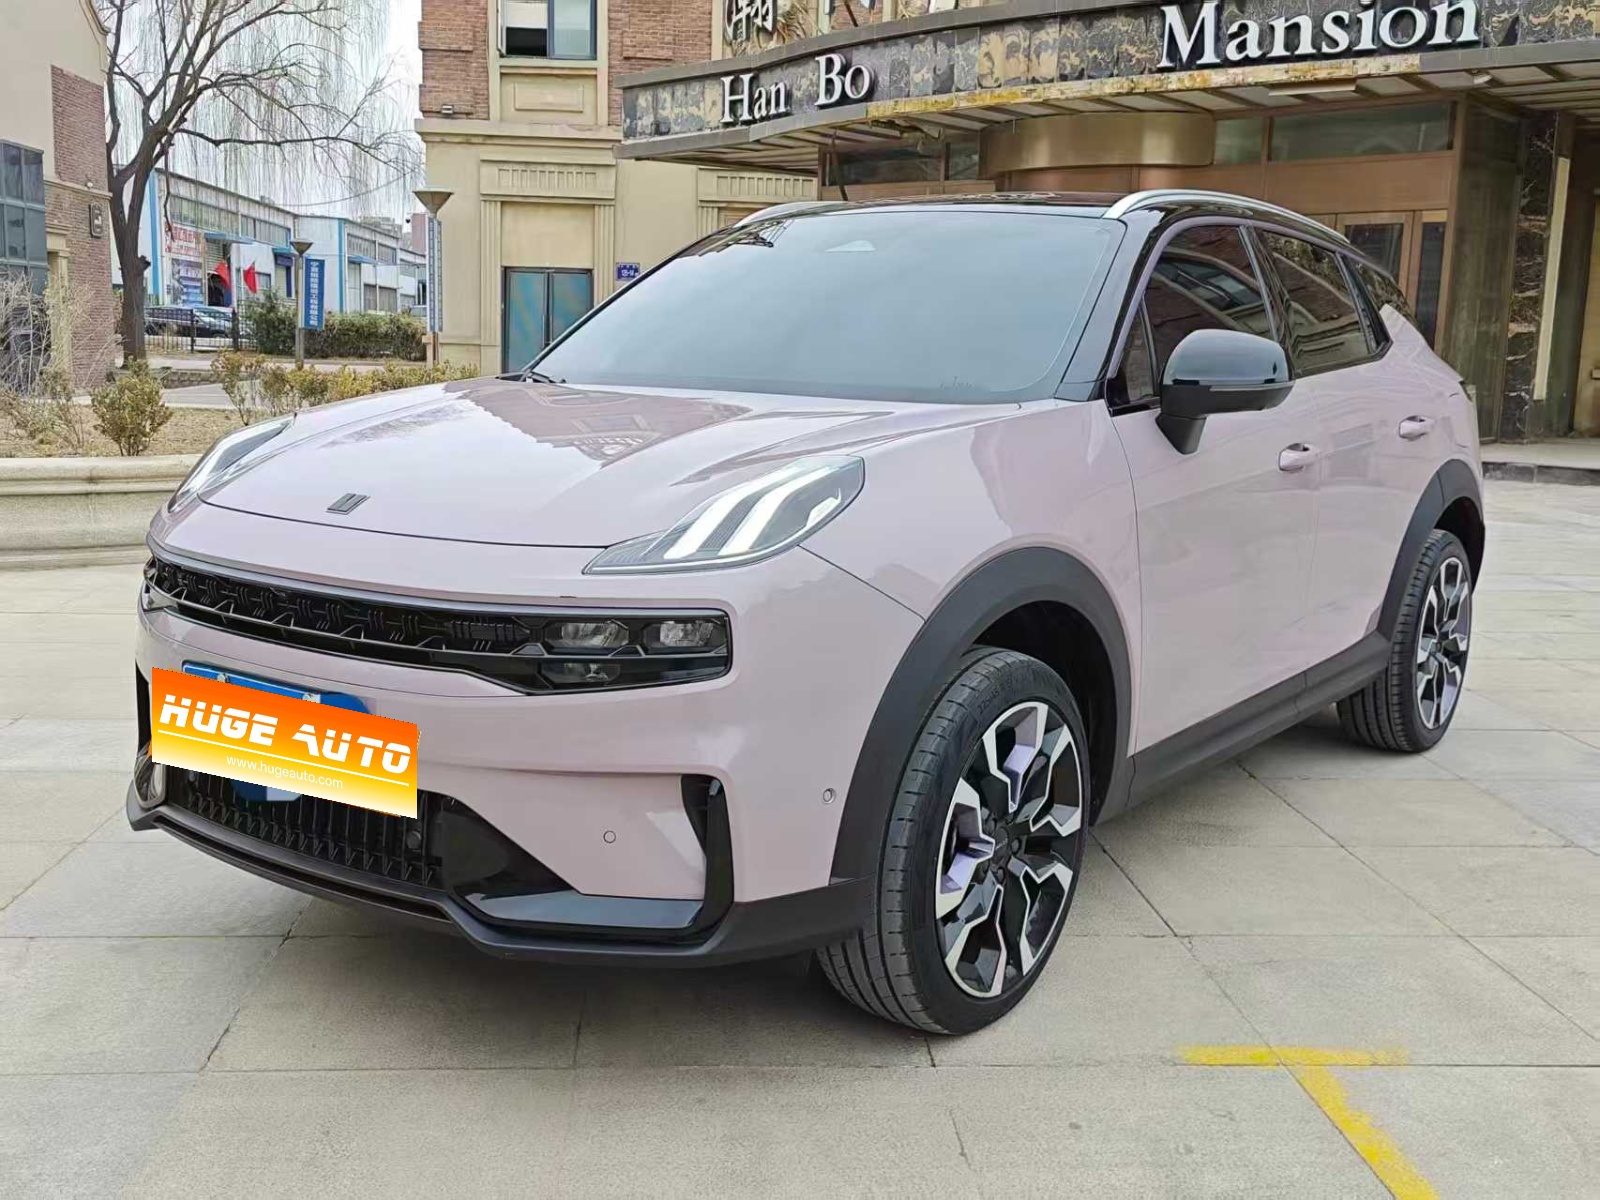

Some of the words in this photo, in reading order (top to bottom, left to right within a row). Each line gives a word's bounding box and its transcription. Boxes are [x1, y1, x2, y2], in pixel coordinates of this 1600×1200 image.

[720, 73, 787, 123] Han
[814, 53, 873, 106] Bo
[1157, 0, 1481, 69] Mansion
